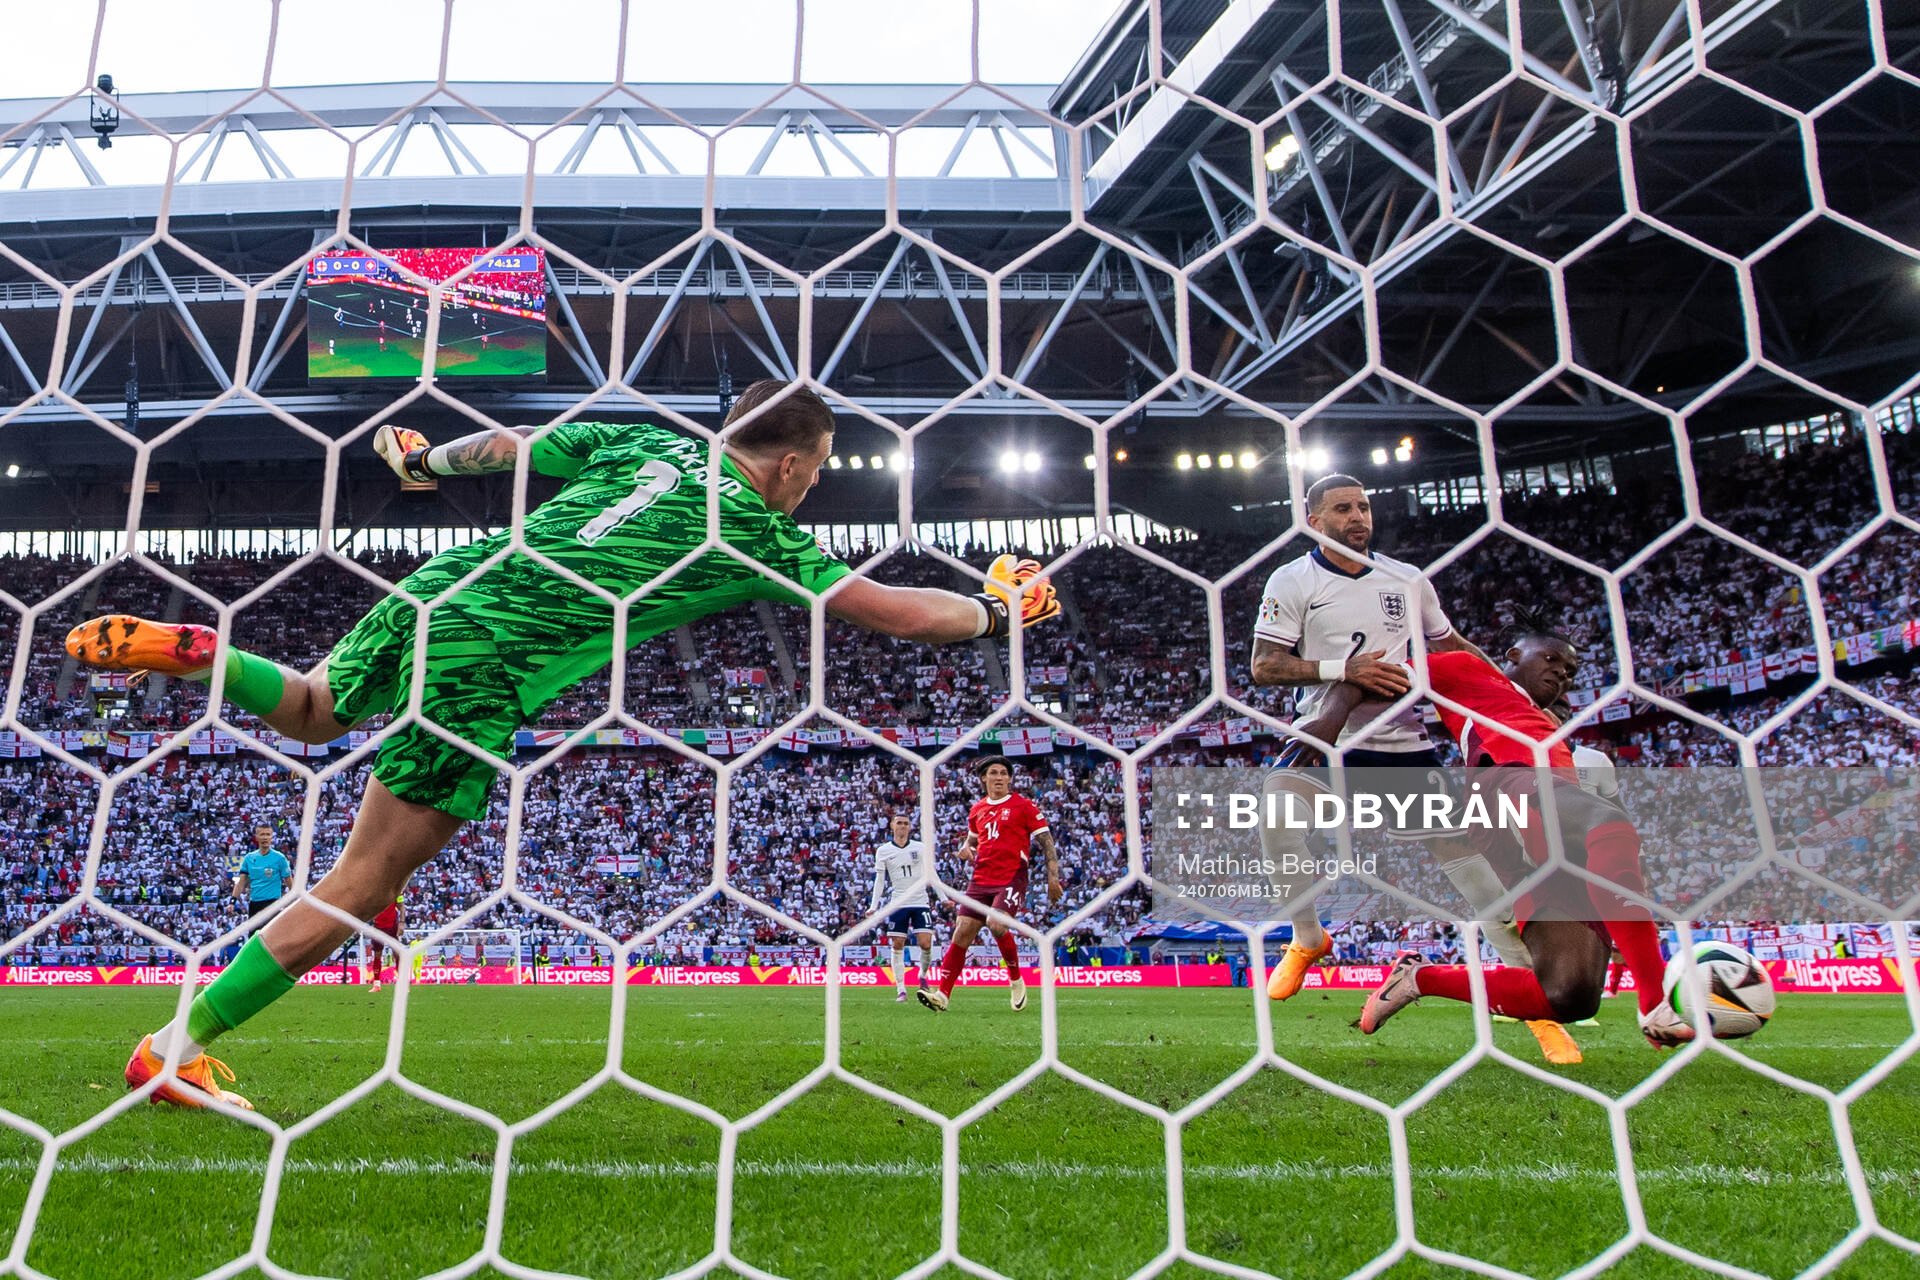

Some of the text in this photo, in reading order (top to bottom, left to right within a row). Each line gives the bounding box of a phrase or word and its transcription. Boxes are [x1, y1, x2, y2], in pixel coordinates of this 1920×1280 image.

[488, 258, 521, 268] 74:12
[576, 460, 681, 546] 1
[1349, 631, 1367, 659] 2
[984, 821, 1000, 841] 14
[900, 865, 912, 877] 11
[1005, 887, 1019, 906] 14
[921, 911, 932, 924] 11
[6, 967, 93, 985] AliExpress
[132, 967, 219, 985] AliExpess
[522, 967, 611, 985] AliExpress
[651, 967, 741, 985] AliExpress
[1053, 966, 1142, 986] AliExpress
[1785, 959, 1883, 992] AliExpress
